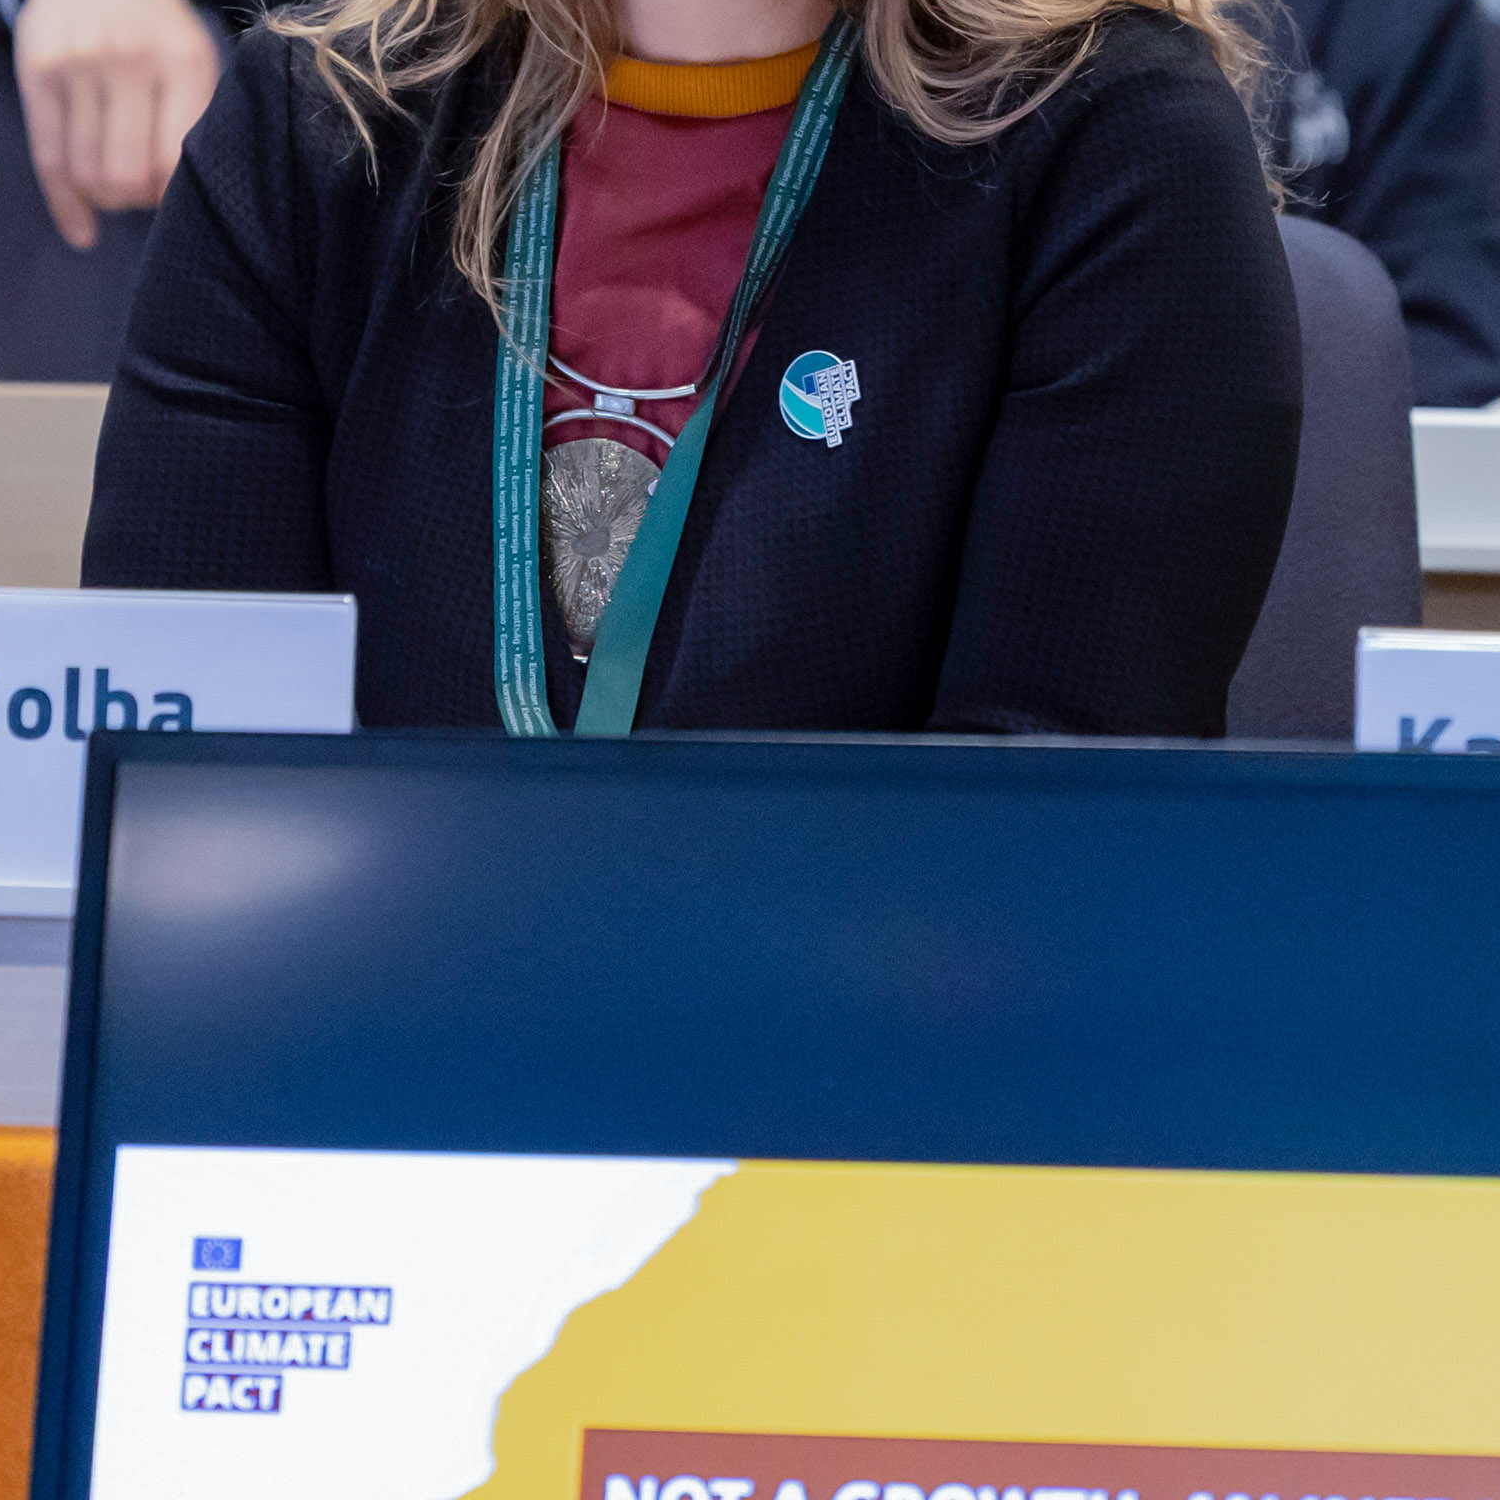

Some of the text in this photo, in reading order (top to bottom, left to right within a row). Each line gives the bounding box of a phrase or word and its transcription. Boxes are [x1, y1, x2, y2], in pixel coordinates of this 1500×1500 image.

[830, 366, 848, 425] CLIMATE
[843, 362, 857, 399] PACT
[817, 370, 838, 443] EUROPEAN
[190, 1284, 390, 1322] EUROPEAN
[187, 1330, 346, 1367] CLIMATE
[184, 1375, 278, 1410] PACT
